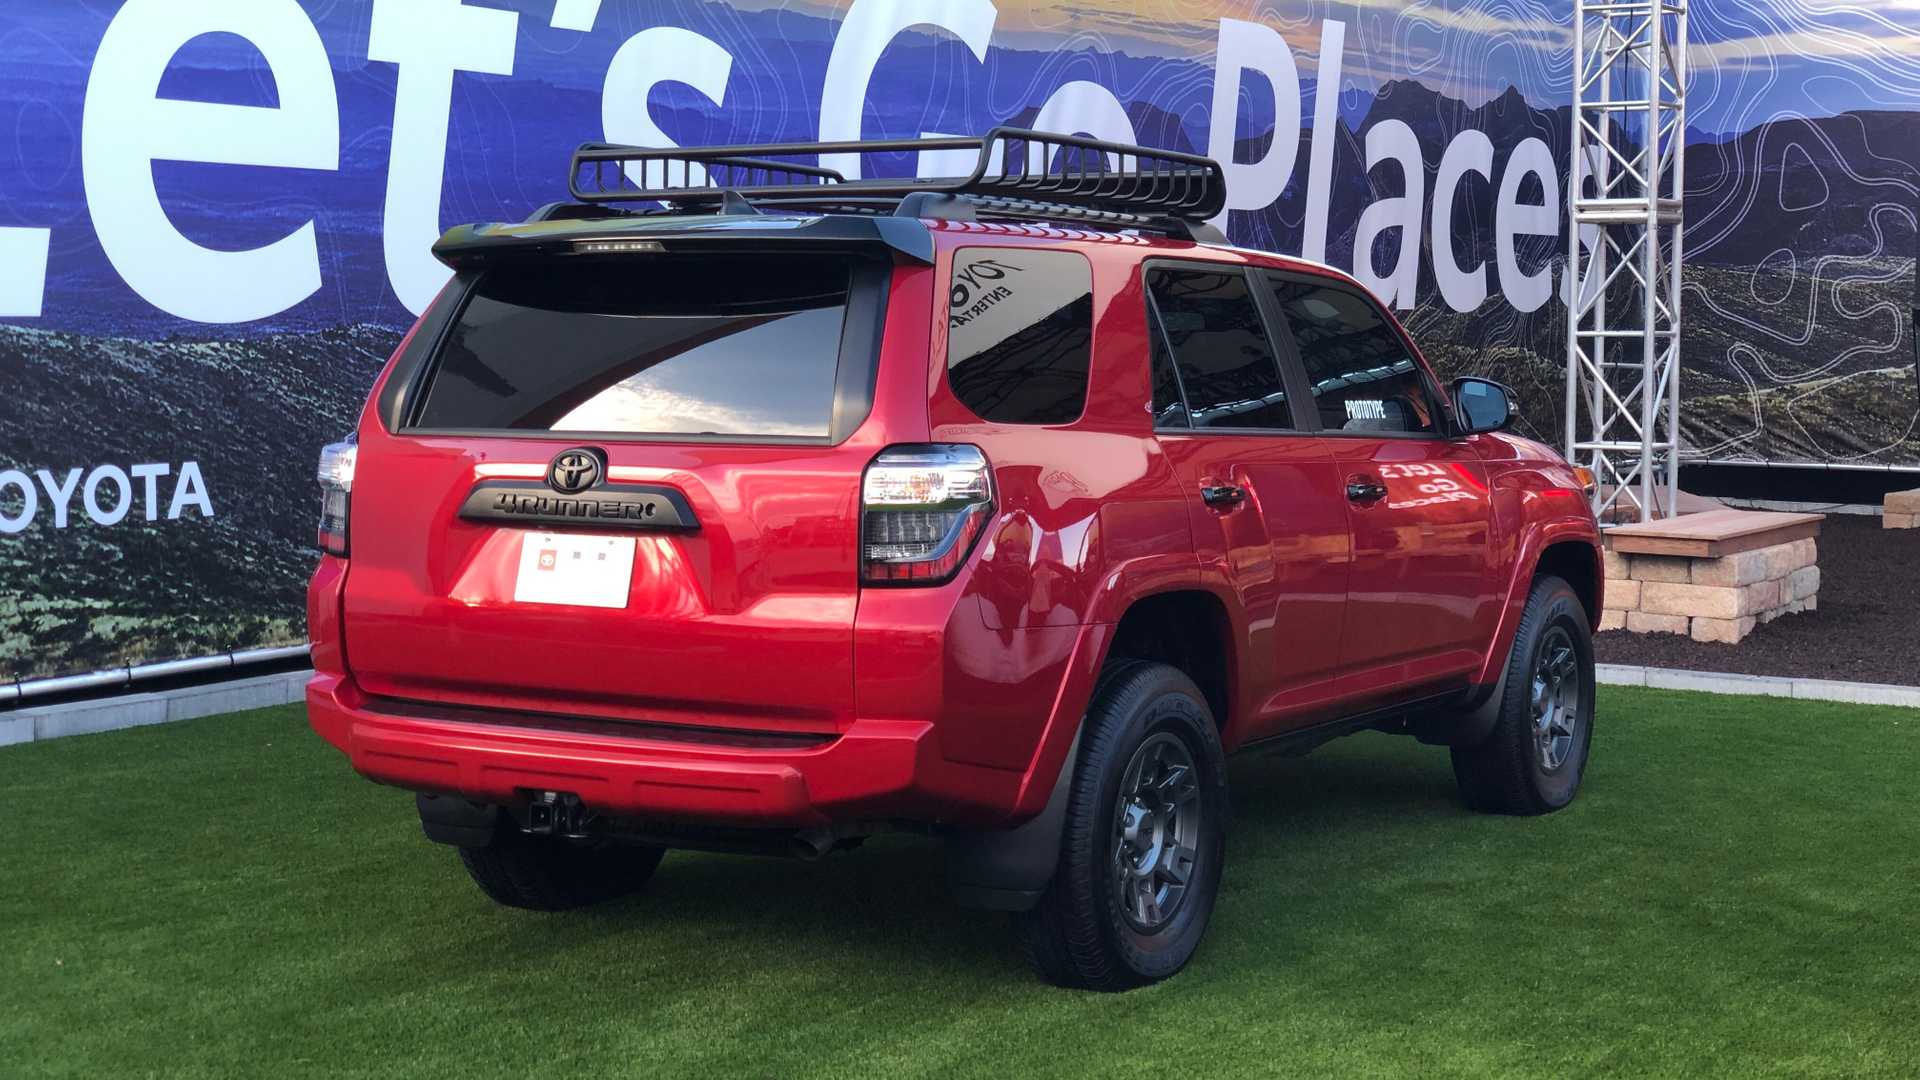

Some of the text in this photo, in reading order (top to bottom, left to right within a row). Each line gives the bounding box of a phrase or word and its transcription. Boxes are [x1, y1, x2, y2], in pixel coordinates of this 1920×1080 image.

[0, 0, 732, 323] et's
[1209, 17, 1611, 313] Places
[1344, 400, 1386, 418] PROTOTYPE
[493, 494, 644, 519] 4RUNNER
